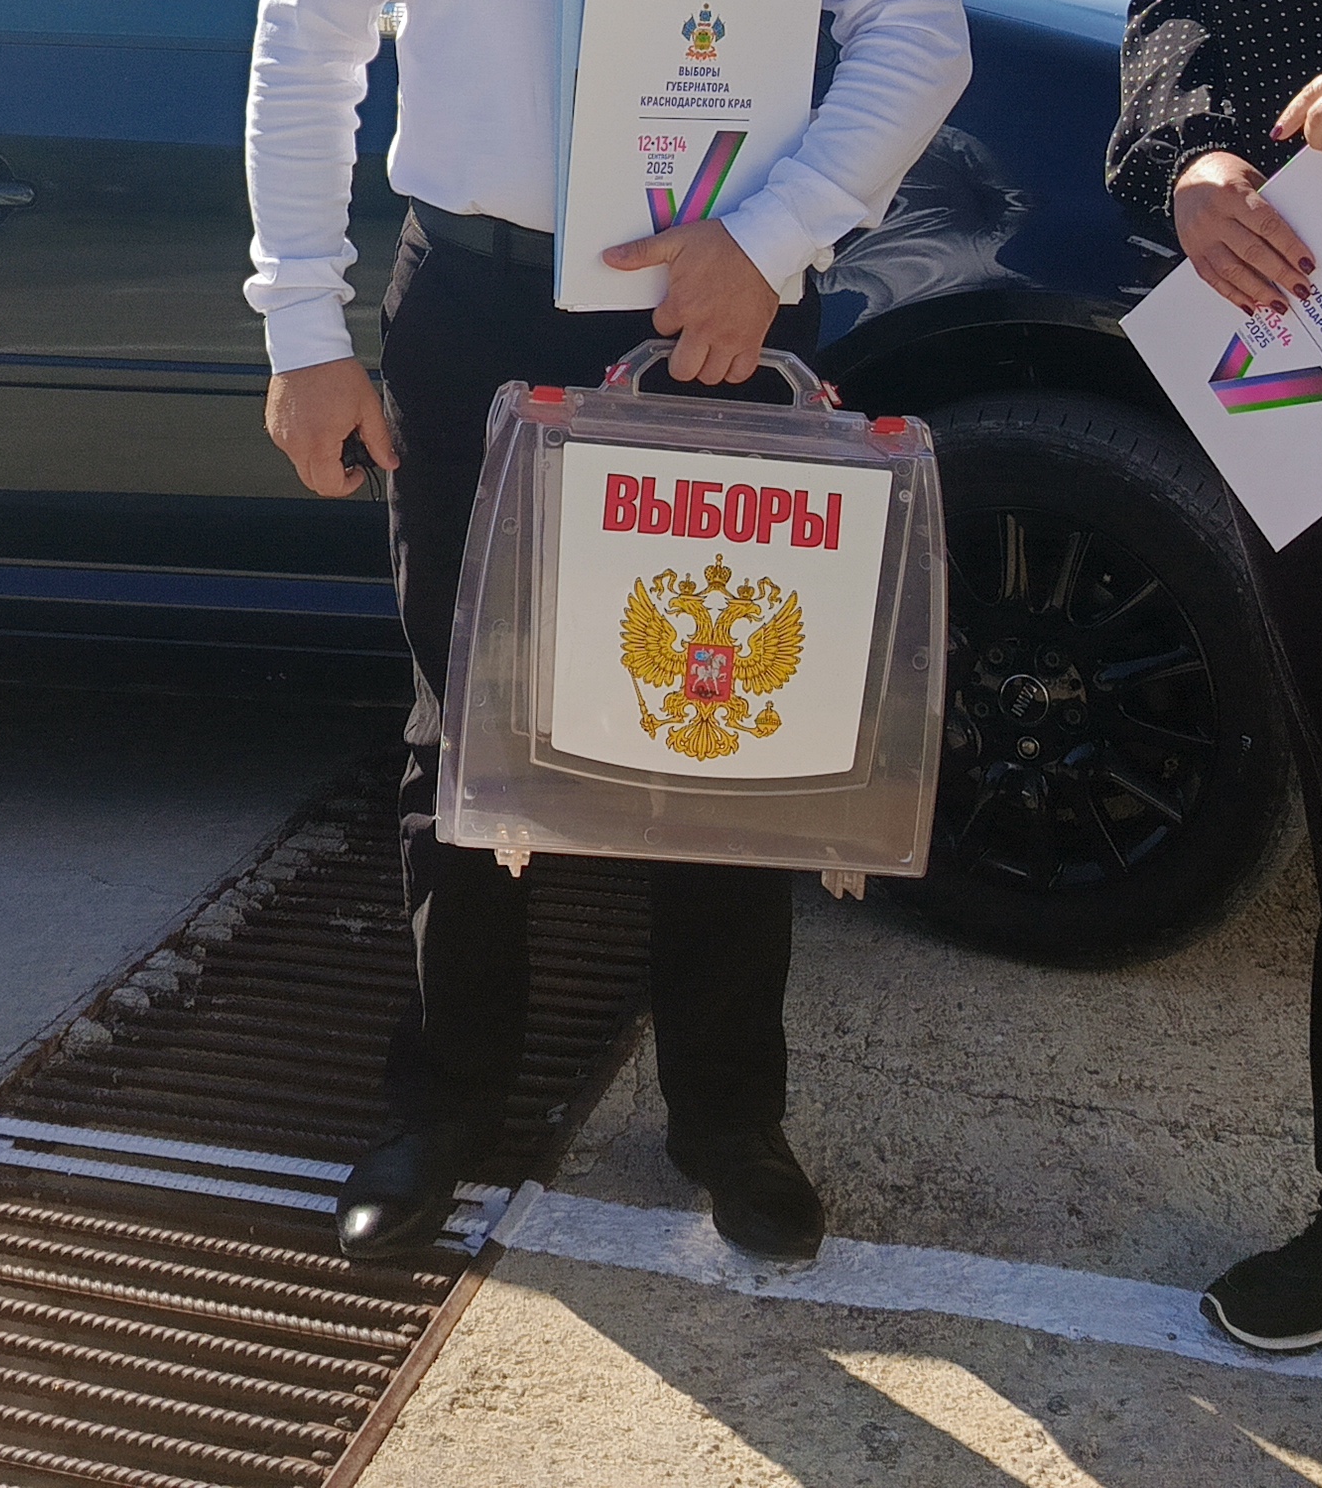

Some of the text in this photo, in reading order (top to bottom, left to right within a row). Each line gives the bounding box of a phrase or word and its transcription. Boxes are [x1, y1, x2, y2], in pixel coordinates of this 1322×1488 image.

[678, 66, 720, 77] ВЫБОРЫ
[666, 81, 729, 92] ГУБЕРНАТОРА
[640, 96, 752, 109] КРАСНОДАРСКОГО КРАЯ
[646, 161, 674, 174] 2025
[1245, 318, 1270, 348] 2025
[602, 473, 843, 550] ВЫБОРЫ
